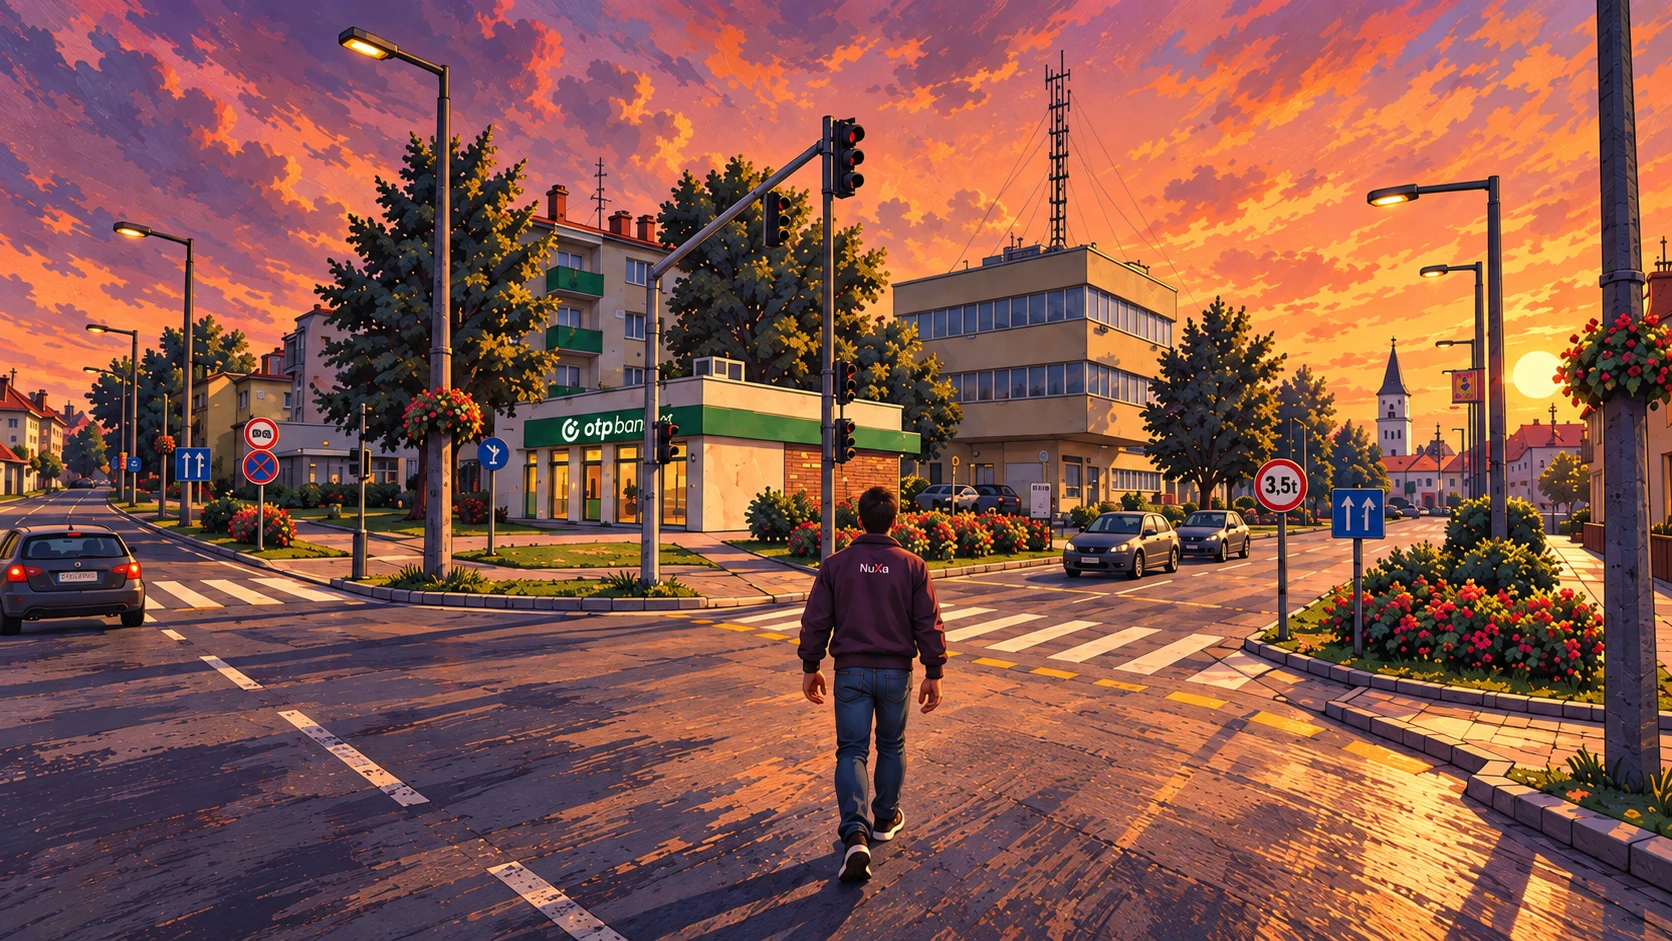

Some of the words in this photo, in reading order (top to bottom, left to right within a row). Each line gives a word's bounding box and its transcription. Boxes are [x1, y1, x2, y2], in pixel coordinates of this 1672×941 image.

[584, 414, 645, 441] otpban
[1265, 475, 1298, 496] 3,5t
[860, 563, 889, 574] NuXa
